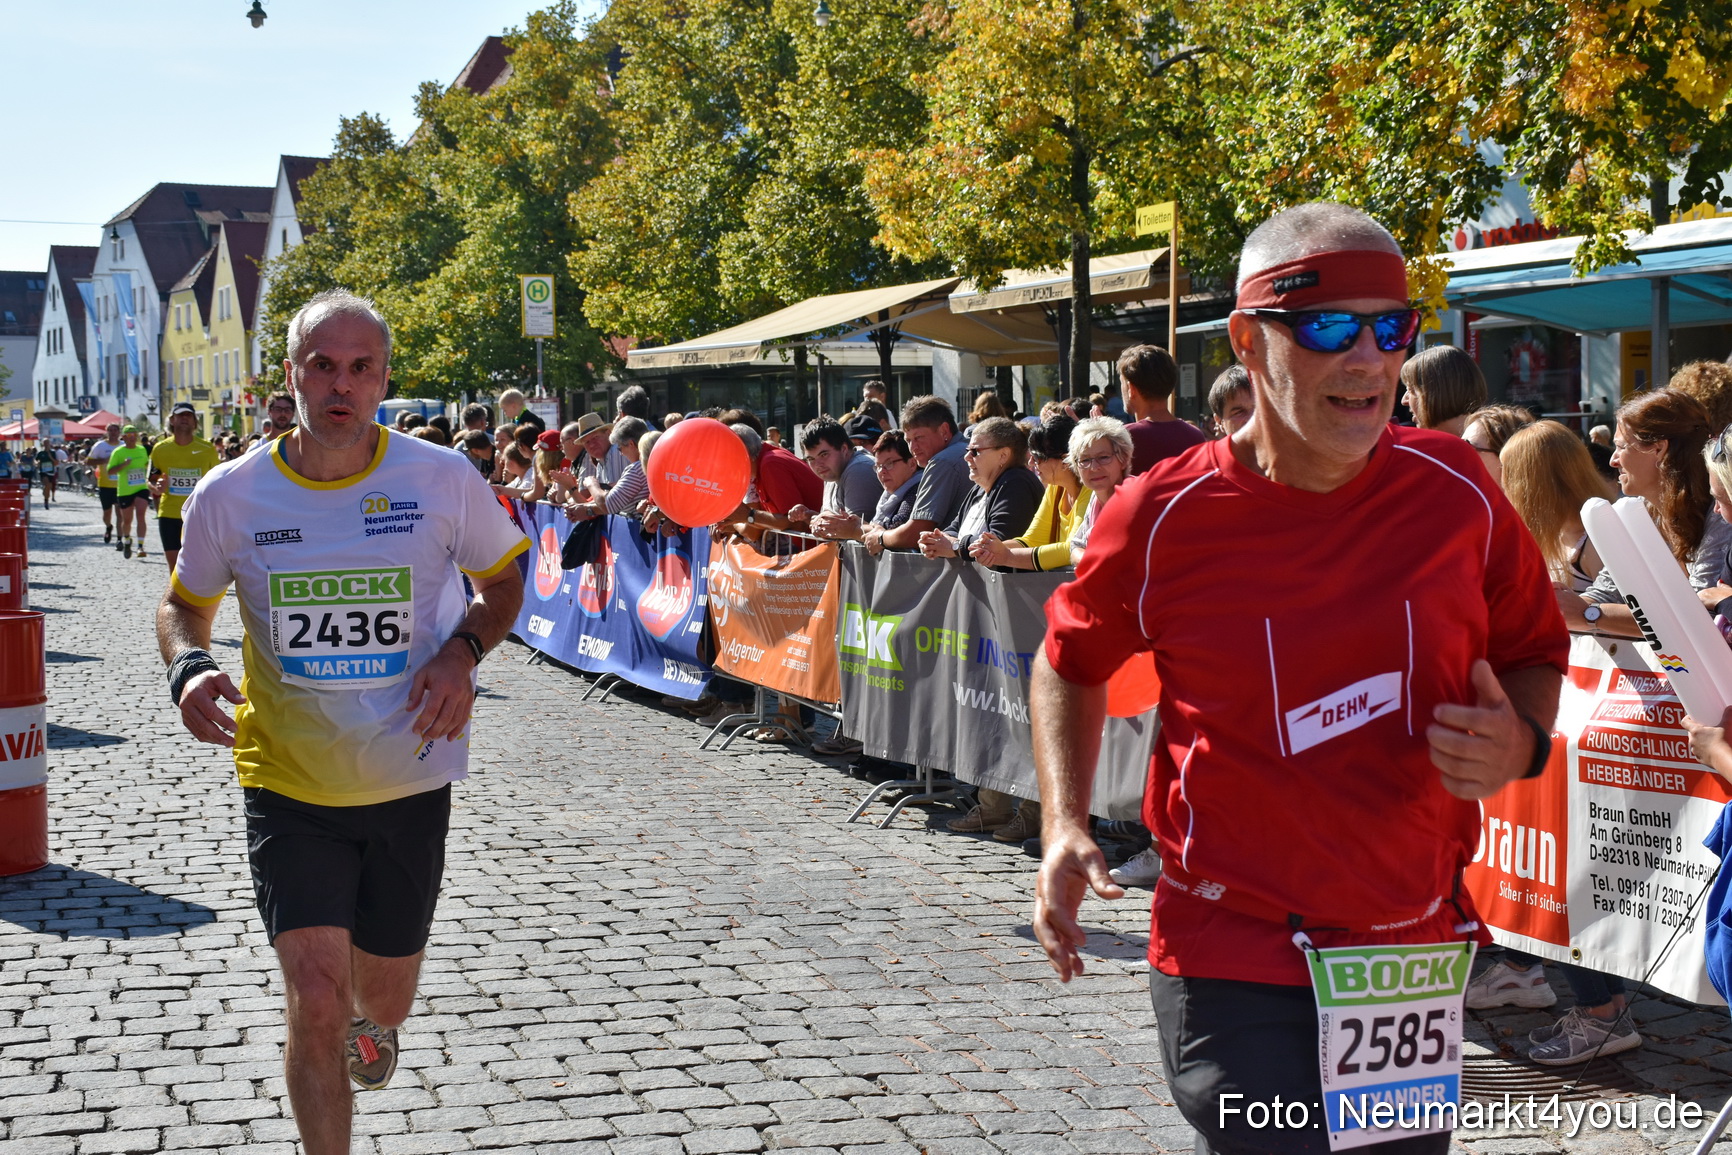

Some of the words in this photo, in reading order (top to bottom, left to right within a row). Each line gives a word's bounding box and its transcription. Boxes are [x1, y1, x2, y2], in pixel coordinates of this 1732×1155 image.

[1143, 211, 1172, 226] Toiletten
[1482, 218, 1556, 247] vodafo
[171, 477, 198, 487] 2632
[364, 497, 389, 514] 20
[392, 502, 416, 511] JAHRE
[364, 512, 426, 525] Neumarkter
[365, 523, 415, 537] Stadtlauf
[255, 529, 302, 542] BOCK
[282, 574, 402, 600] BOCK
[796, 581, 806, 590] und
[776, 594, 799, 606] Projekte
[402, 611, 409, 619] D
[288, 611, 401, 649] 2436
[727, 637, 766, 664] Agentur
[303, 659, 387, 676] MARTIN
[1322, 691, 1369, 729] DEHN
[1600, 701, 1684, 725] VERZURRSYST
[1587, 762, 1686, 792] HEBEBÄNDER
[1589, 802, 1625, 823] Braun
[1629, 809, 1672, 829] GmbH
[1590, 823, 1608, 842] Am
[1611, 826, 1673, 855] Grünberg
[1676, 836, 1682, 853] 8
[1589, 844, 1640, 867] D-92318
[1499, 881, 1522, 902] Sicher
[1526, 889, 1538, 906] ist
[1540, 892, 1568, 915] sicher
[1590, 873, 1614, 893] Tel.
[1617, 877, 1651, 900] 09181
[1662, 886, 1693, 911] 2307-0
[1593, 893, 1615, 913] Fax
[1619, 898, 1651, 921] 09181
[1371, 923, 1388, 931] new
[1388, 916, 1419, 930] balance
[1329, 954, 1455, 994] BOCK
[1337, 1008, 1446, 1077] 2585
